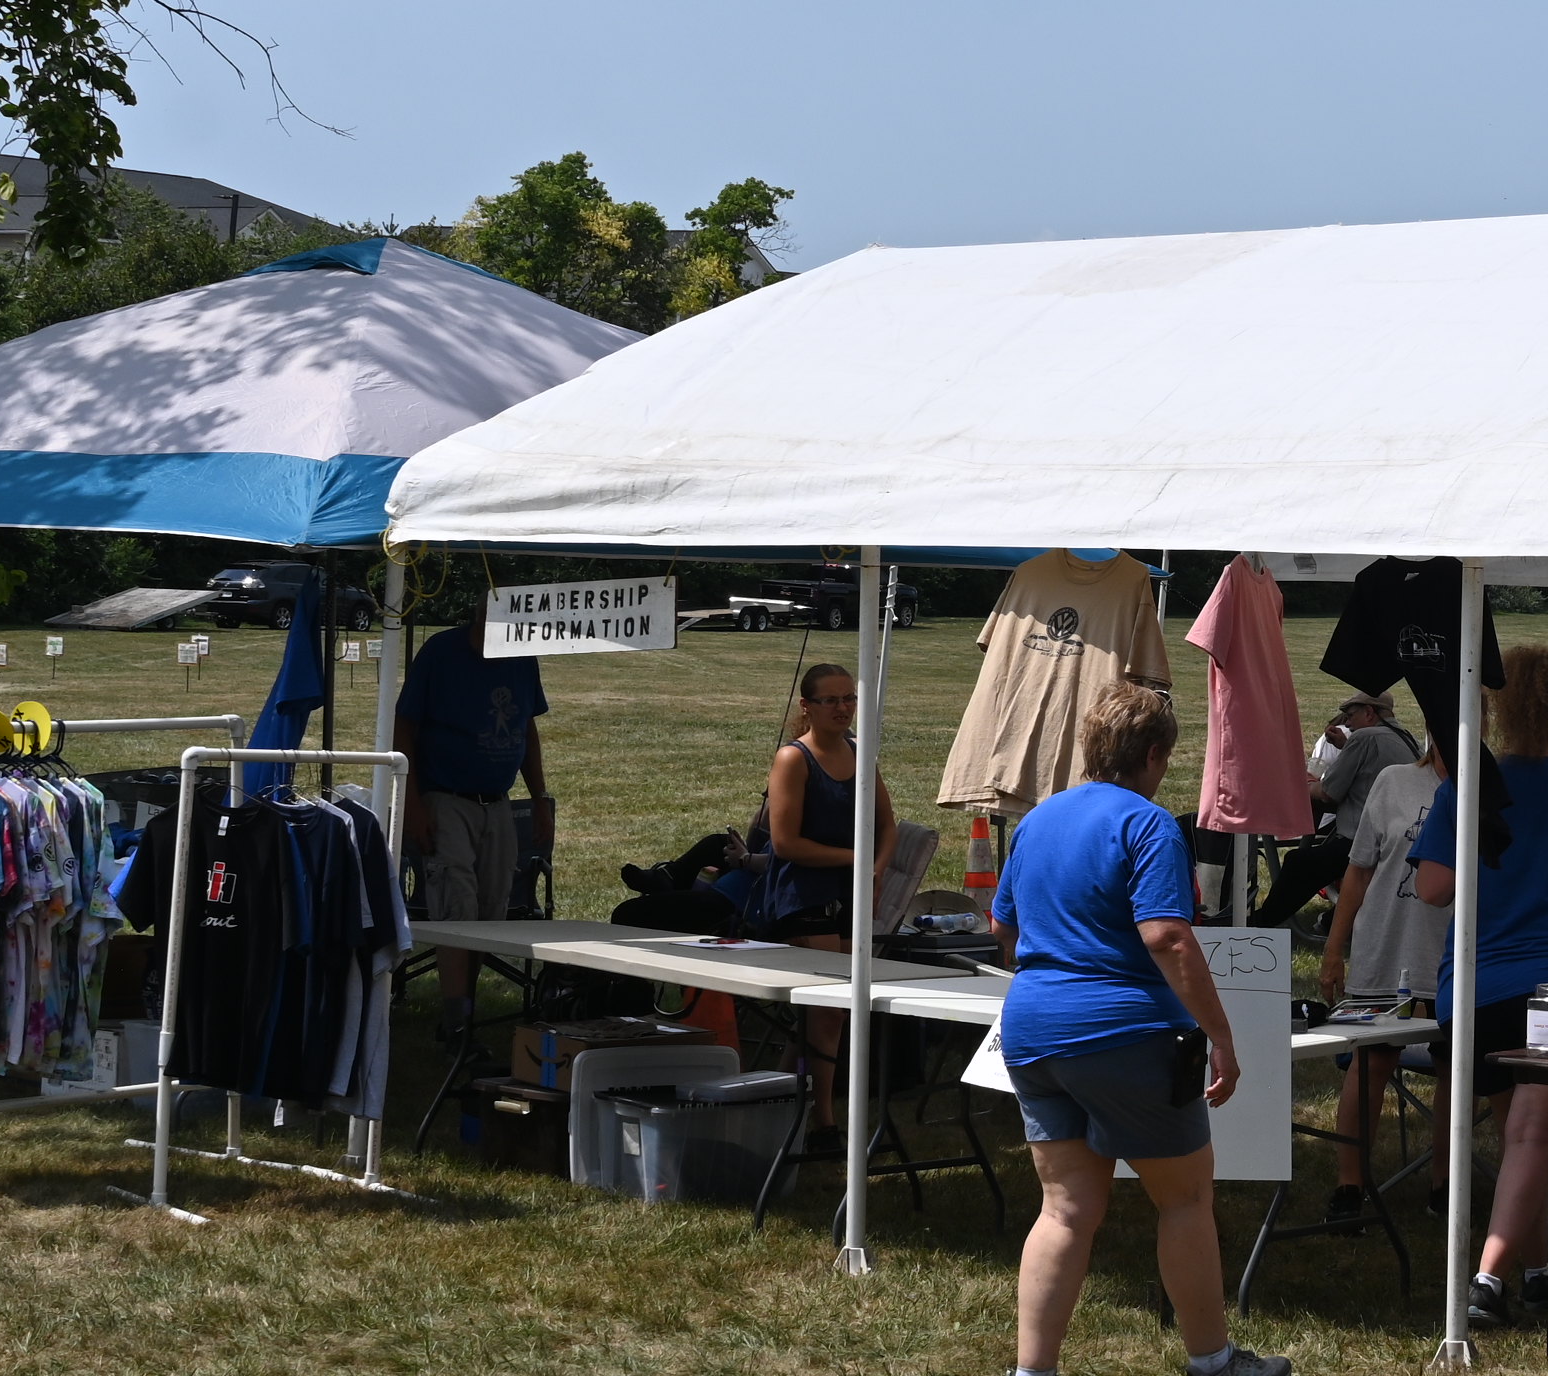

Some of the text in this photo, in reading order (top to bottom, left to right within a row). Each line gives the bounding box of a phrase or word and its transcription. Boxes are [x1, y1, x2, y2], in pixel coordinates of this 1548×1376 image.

[510, 585, 649, 613] MEMBERSHIP
[506, 615, 650, 642] INFORMATION
[1203, 936, 1277, 977] ZES
